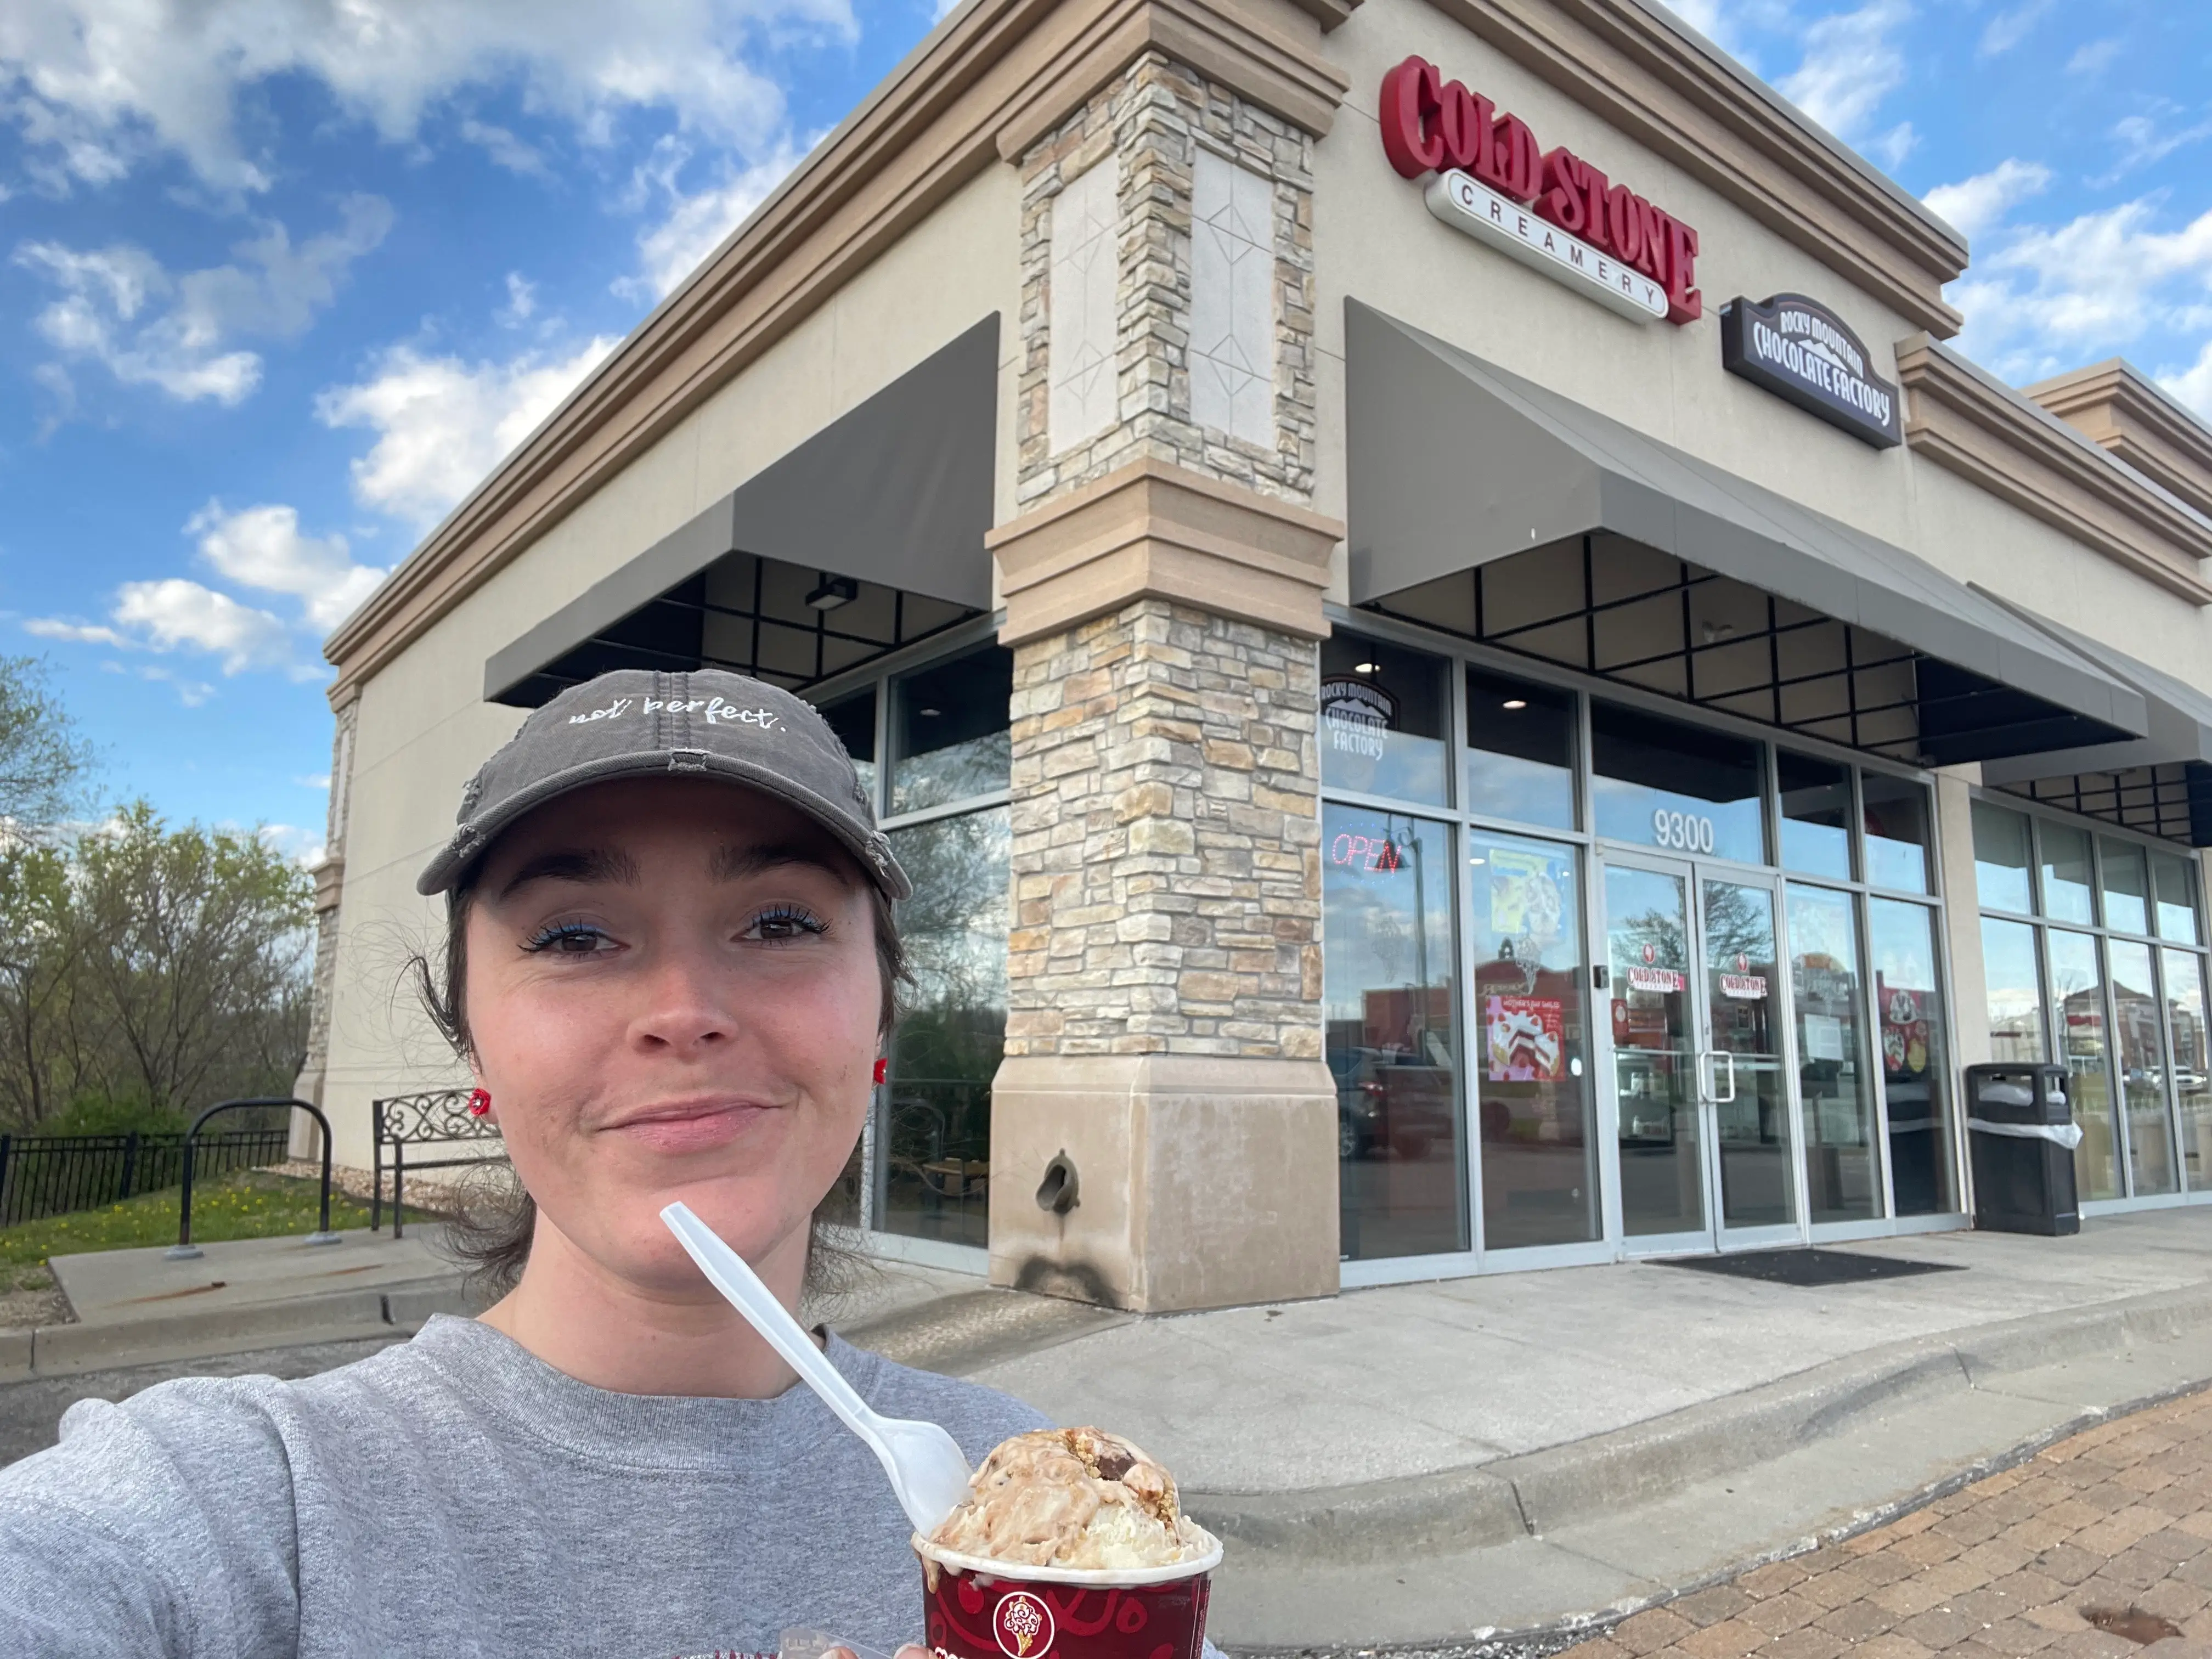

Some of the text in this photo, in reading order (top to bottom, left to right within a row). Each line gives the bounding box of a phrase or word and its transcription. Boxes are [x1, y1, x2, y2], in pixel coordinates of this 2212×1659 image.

[1379, 55, 1701, 325] COLD STONE
[1461, 184, 1656, 304] CREAMERY
[1780, 311, 1864, 379] ROCKY MOUNTAIN
[1753, 321, 1891, 427] CHOCOLATE FACTORY
[568, 696, 786, 732] not perfect.
[1321, 681, 1392, 716] ROCKY MOUNTAIN
[1325, 707, 1389, 740] CHOCOLATE
[1333, 730, 1384, 761] FACTORY
[1655, 809, 1714, 853] 9300
[1333, 833, 1402, 873] OPEN
[1627, 966, 1650, 985] COLD
[1650, 968, 1679, 989] STONE
